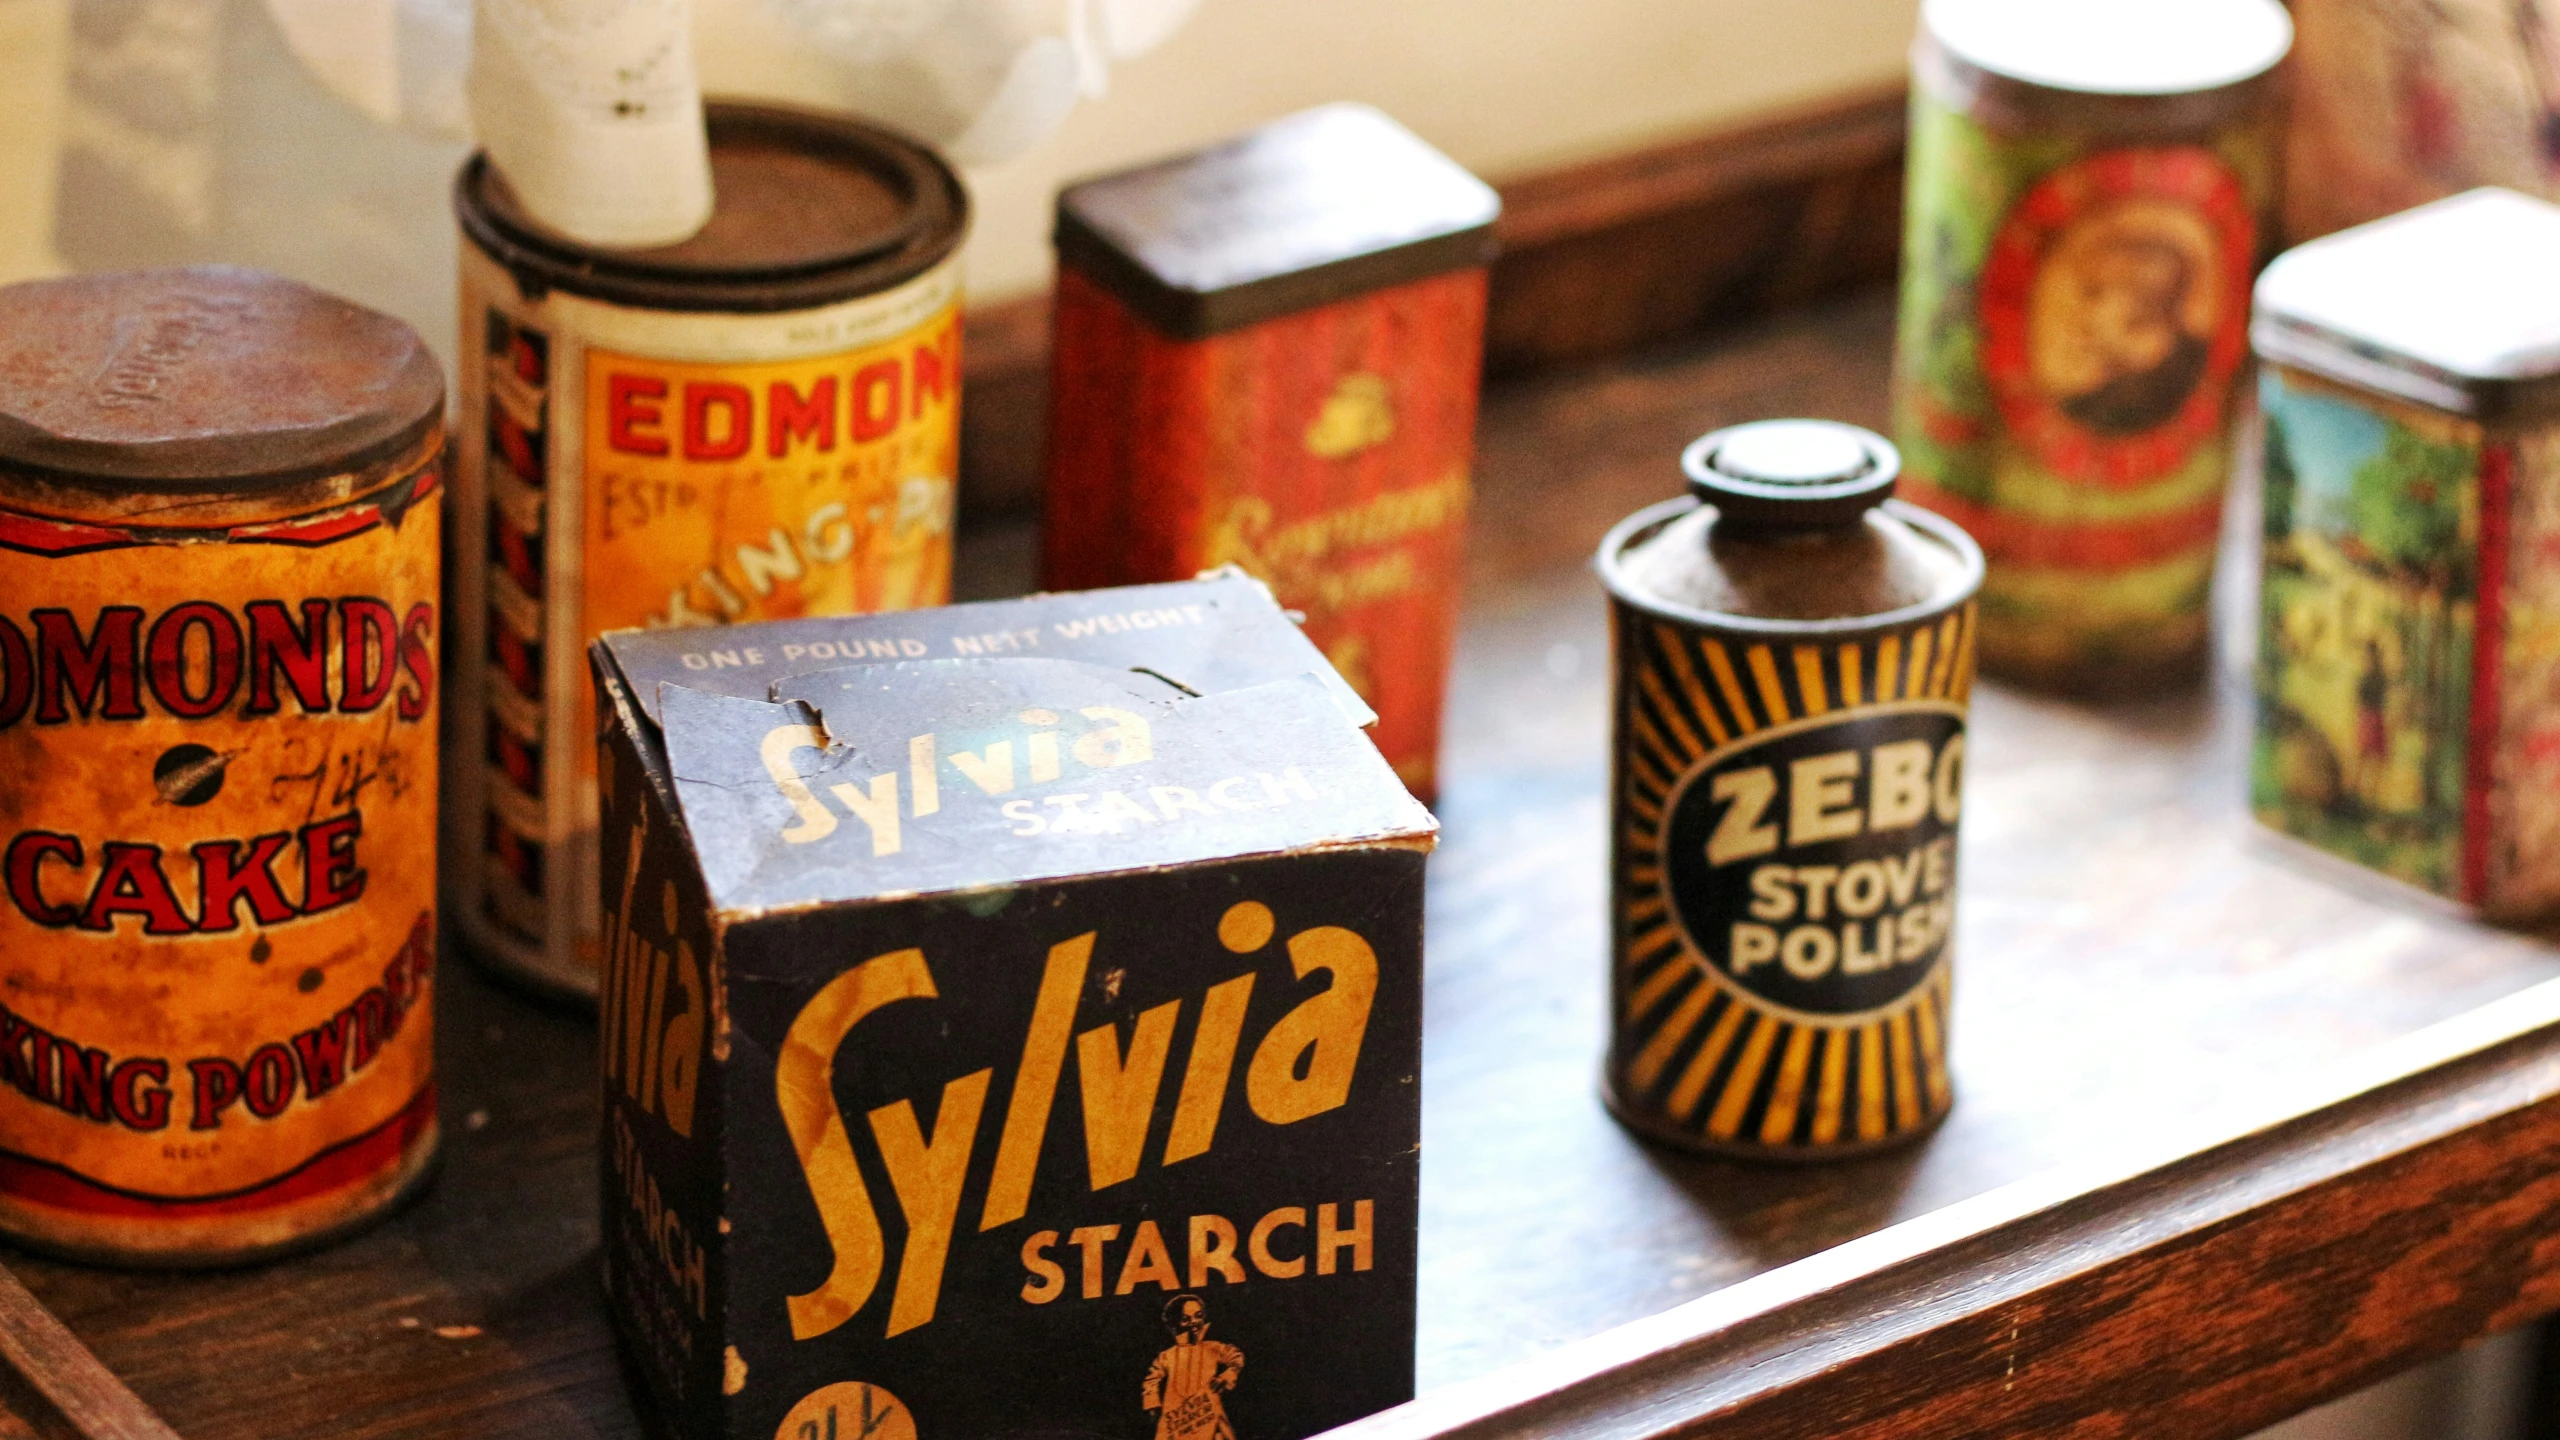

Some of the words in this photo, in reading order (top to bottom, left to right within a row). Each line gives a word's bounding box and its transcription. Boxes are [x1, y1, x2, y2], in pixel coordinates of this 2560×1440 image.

[681, 648, 766, 672] ONE
[784, 638, 928, 663] POUND
[952, 627, 1043, 657] NETT
[1055, 603, 1202, 641] WEIGHT
[759, 704, 1156, 858] Sylvia
[1000, 768, 1320, 838] STARCH
[4, 810, 370, 935] CAKE
[1749, 834, 1957, 922] STOVE
[776, 900, 1380, 1341] Sylvia
[1020, 1199, 1374, 1305] STARCH
